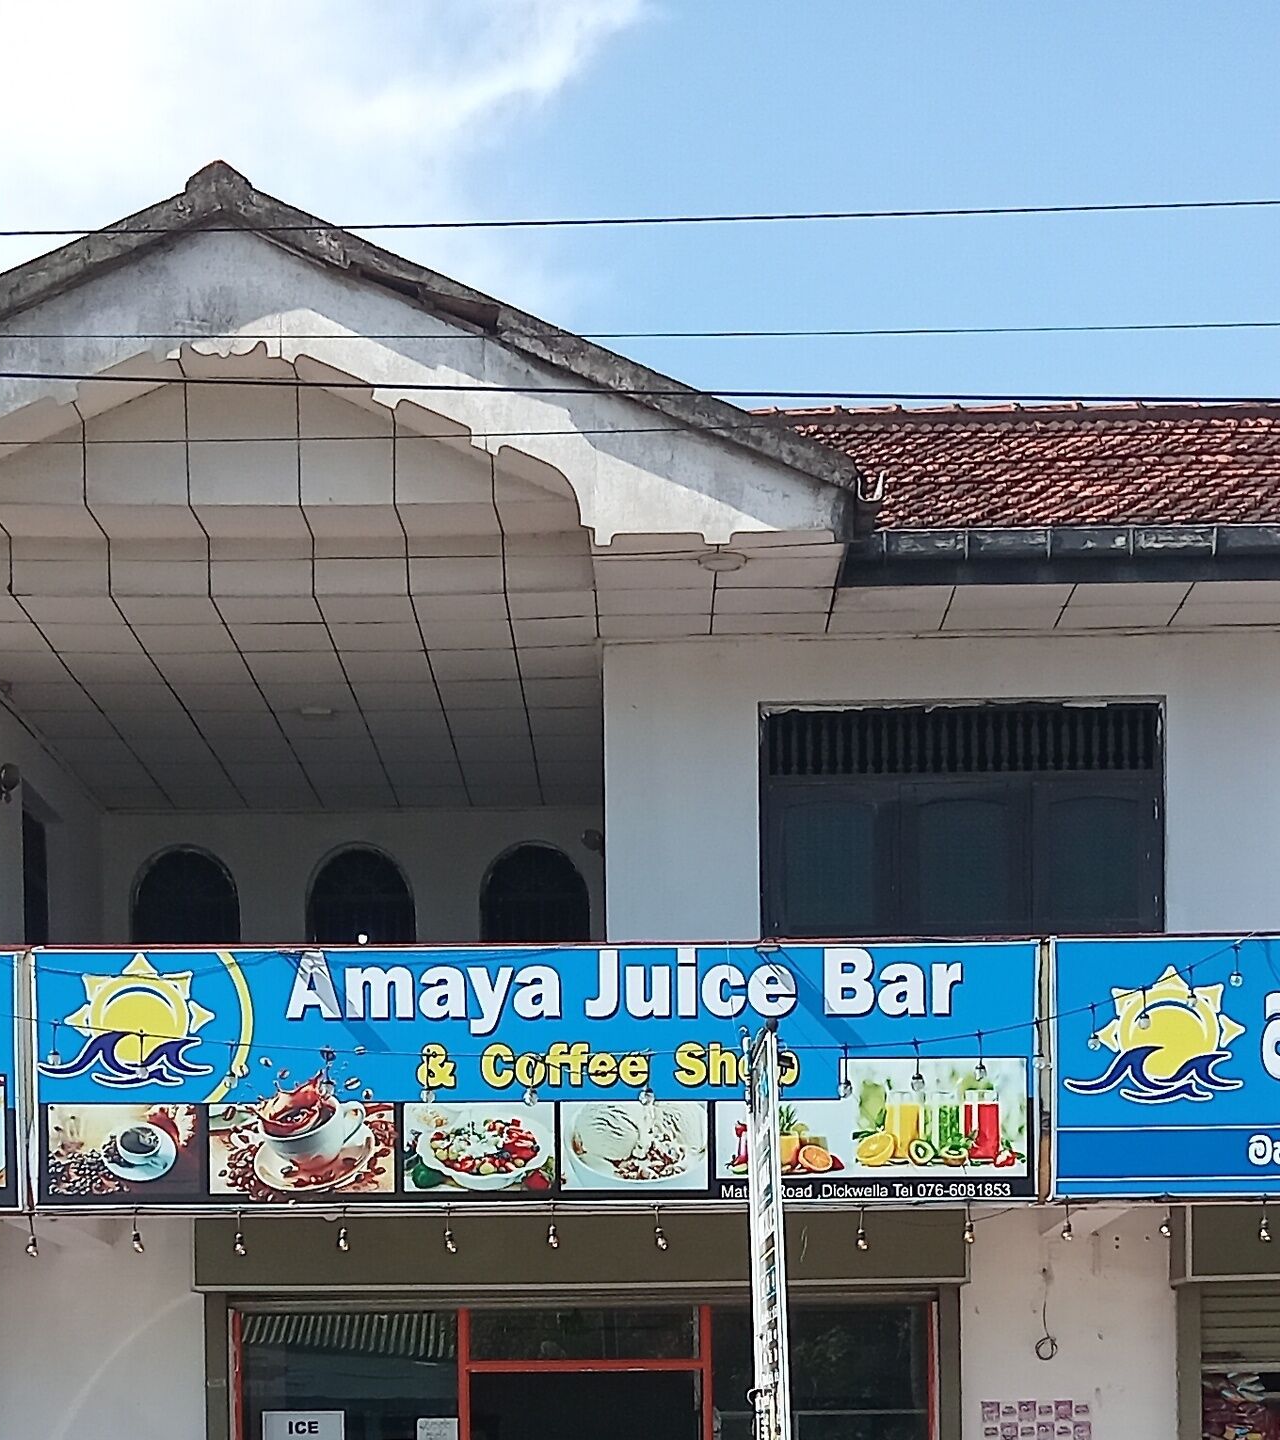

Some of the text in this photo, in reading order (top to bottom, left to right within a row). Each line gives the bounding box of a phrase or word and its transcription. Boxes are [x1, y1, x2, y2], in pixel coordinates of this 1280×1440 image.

[286, 948, 963, 1036] Amaya Juice Bar
[417, 1043, 456, 1088] &
[481, 1043, 649, 1087] Coffee
[893, 1183, 913, 1197] Tel
[917, 1182, 1011, 1197] 076-6081853
[287, 1420, 319, 1435] ICE
